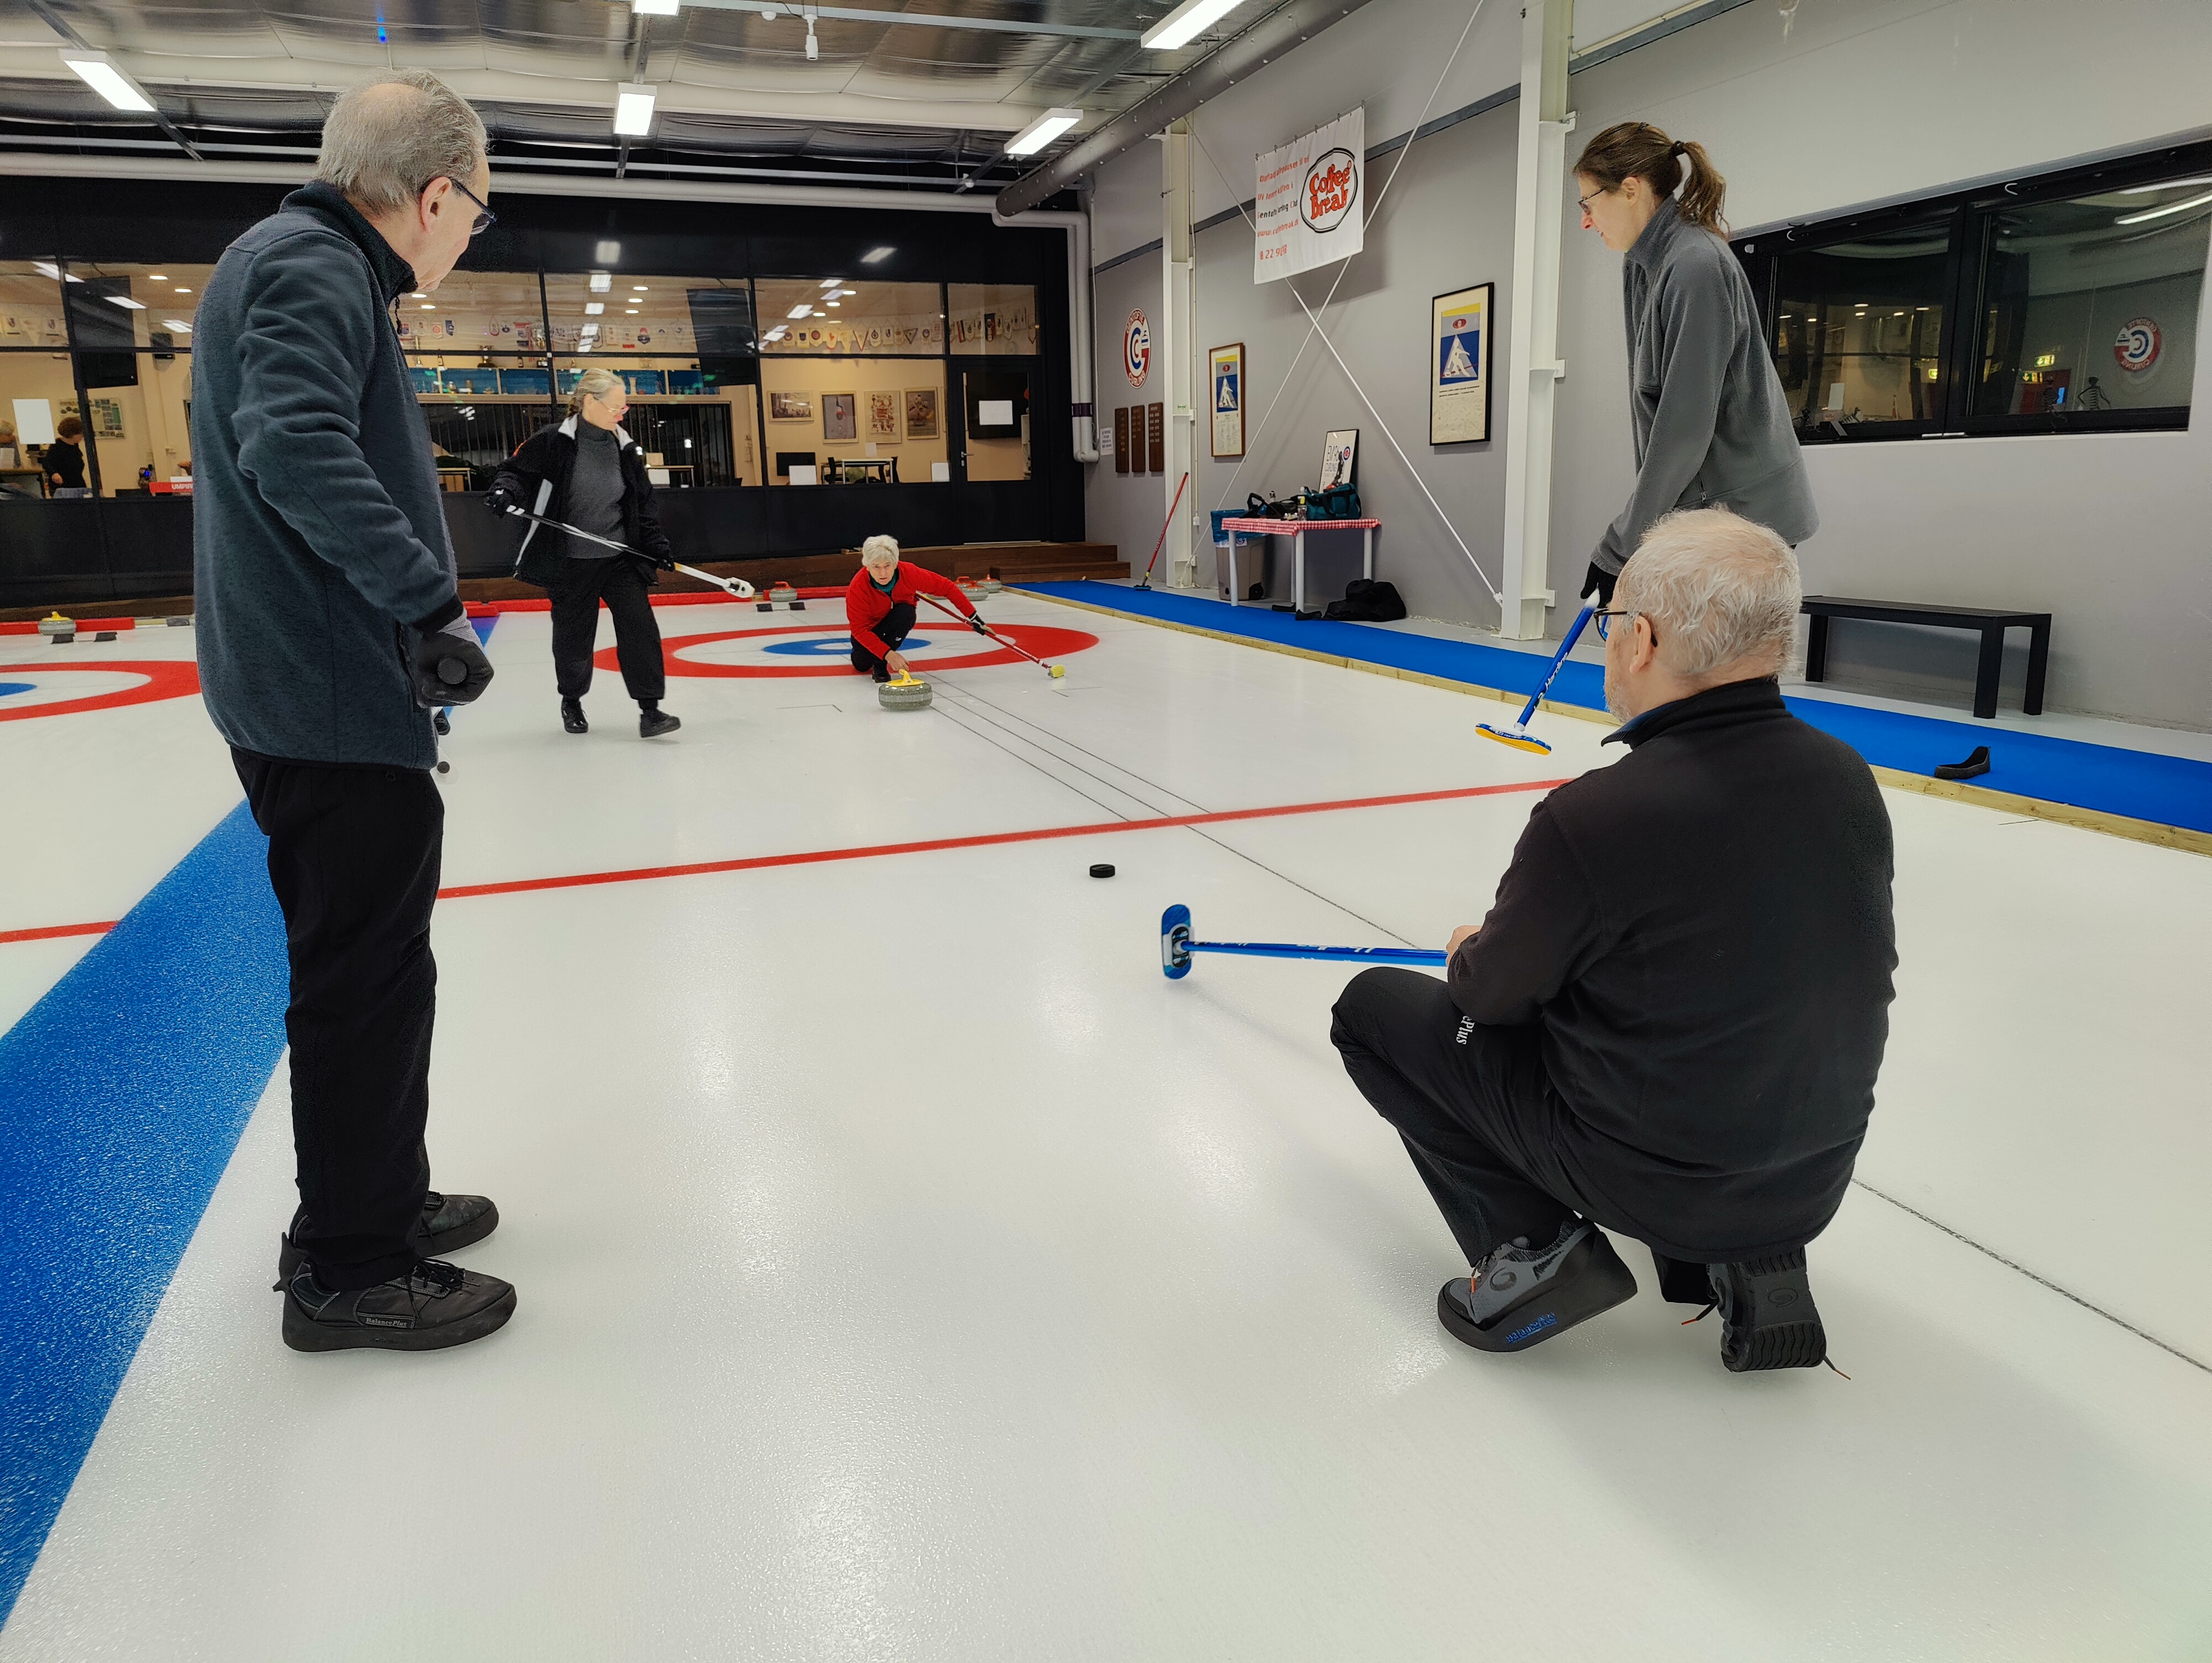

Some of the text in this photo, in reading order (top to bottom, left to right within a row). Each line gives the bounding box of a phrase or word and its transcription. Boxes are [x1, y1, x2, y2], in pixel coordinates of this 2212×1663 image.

[1310, 164, 1350, 195] Coffee
[1310, 184, 1349, 219] Break
[1126, 310, 1145, 334] GENTOFTE
[1129, 370, 1146, 386] CURLING
[366, 1317, 408, 1327] BalancePlus
